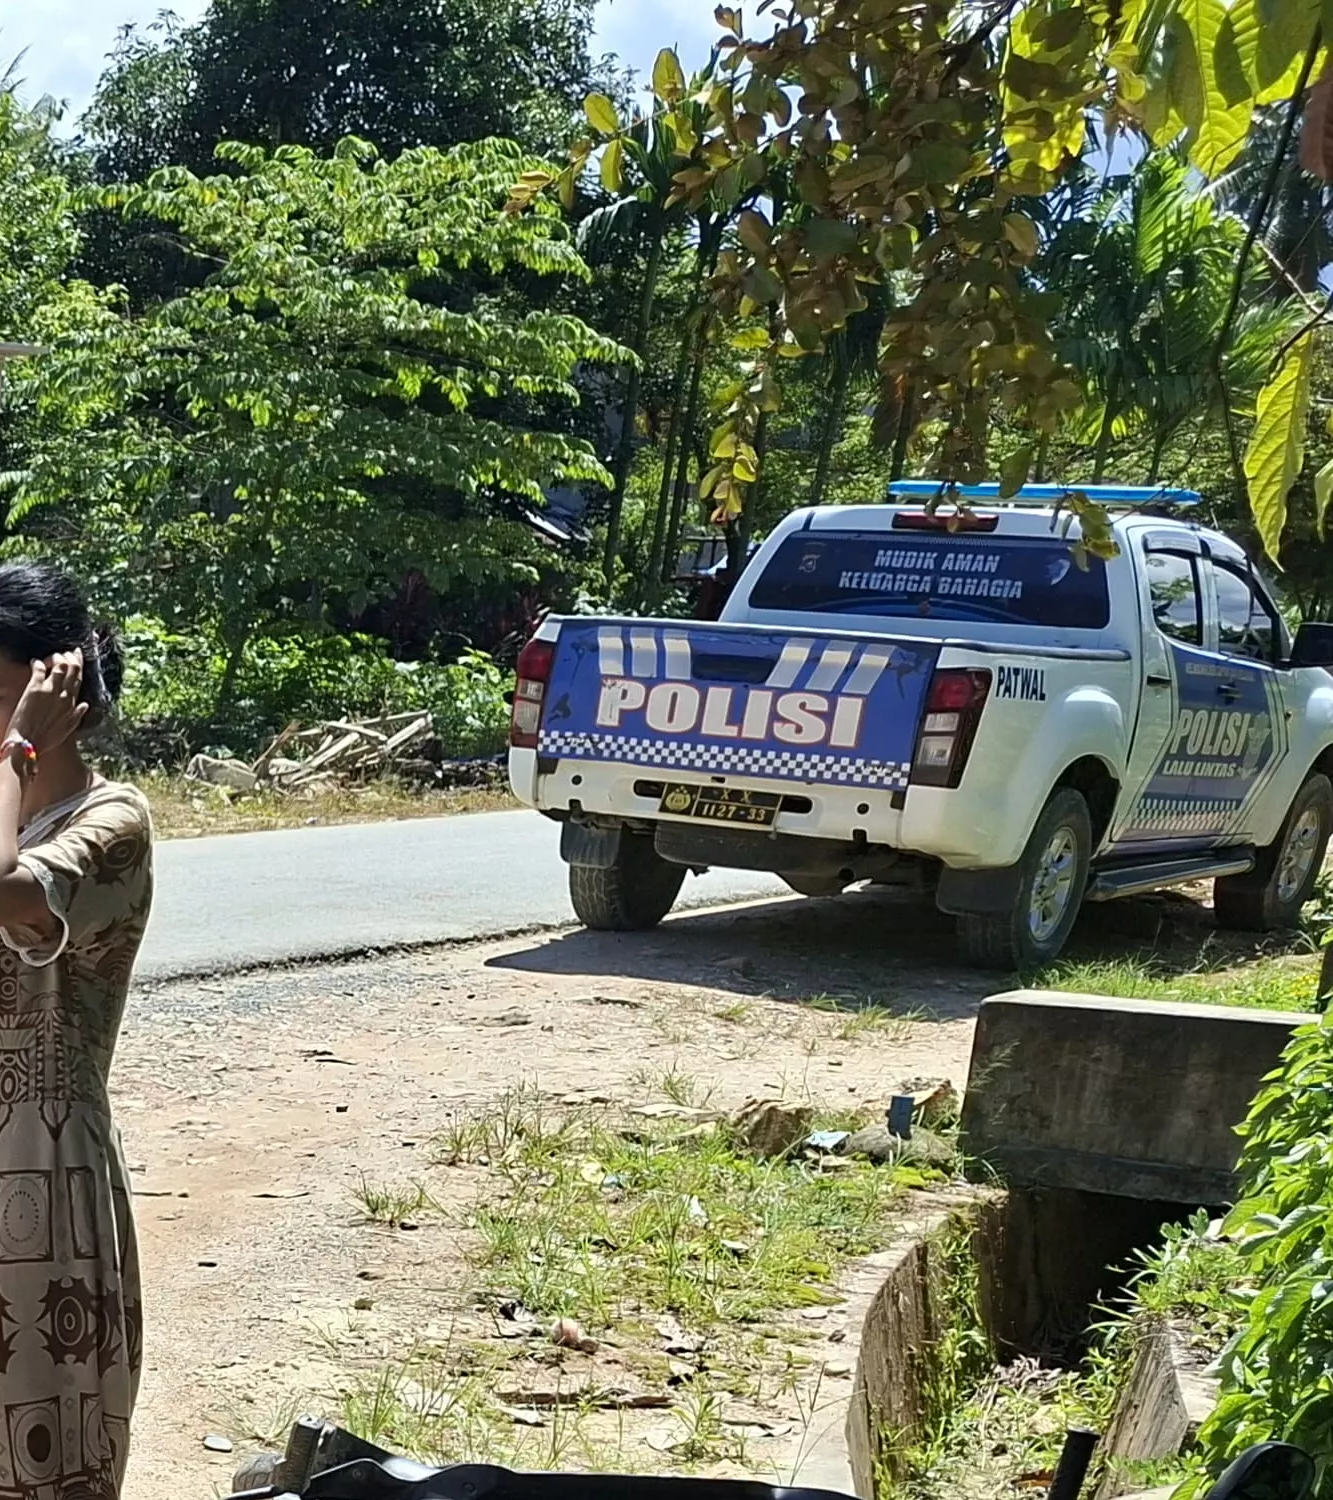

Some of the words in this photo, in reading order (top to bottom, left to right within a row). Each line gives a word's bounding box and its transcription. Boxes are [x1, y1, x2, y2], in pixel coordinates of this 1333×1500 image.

[874, 549, 936, 570] MUDIK
[941, 553, 1000, 573] AMAN
[838, 571, 931, 593] KELUARGA
[937, 576, 1022, 599] BAHAGIA
[995, 665, 1046, 701] PATWAL
[596, 679, 865, 748] POLISI
[1169, 709, 1251, 756] POLISI
[1162, 759, 1193, 777] LALU
[1194, 761, 1237, 777] LINTAS
